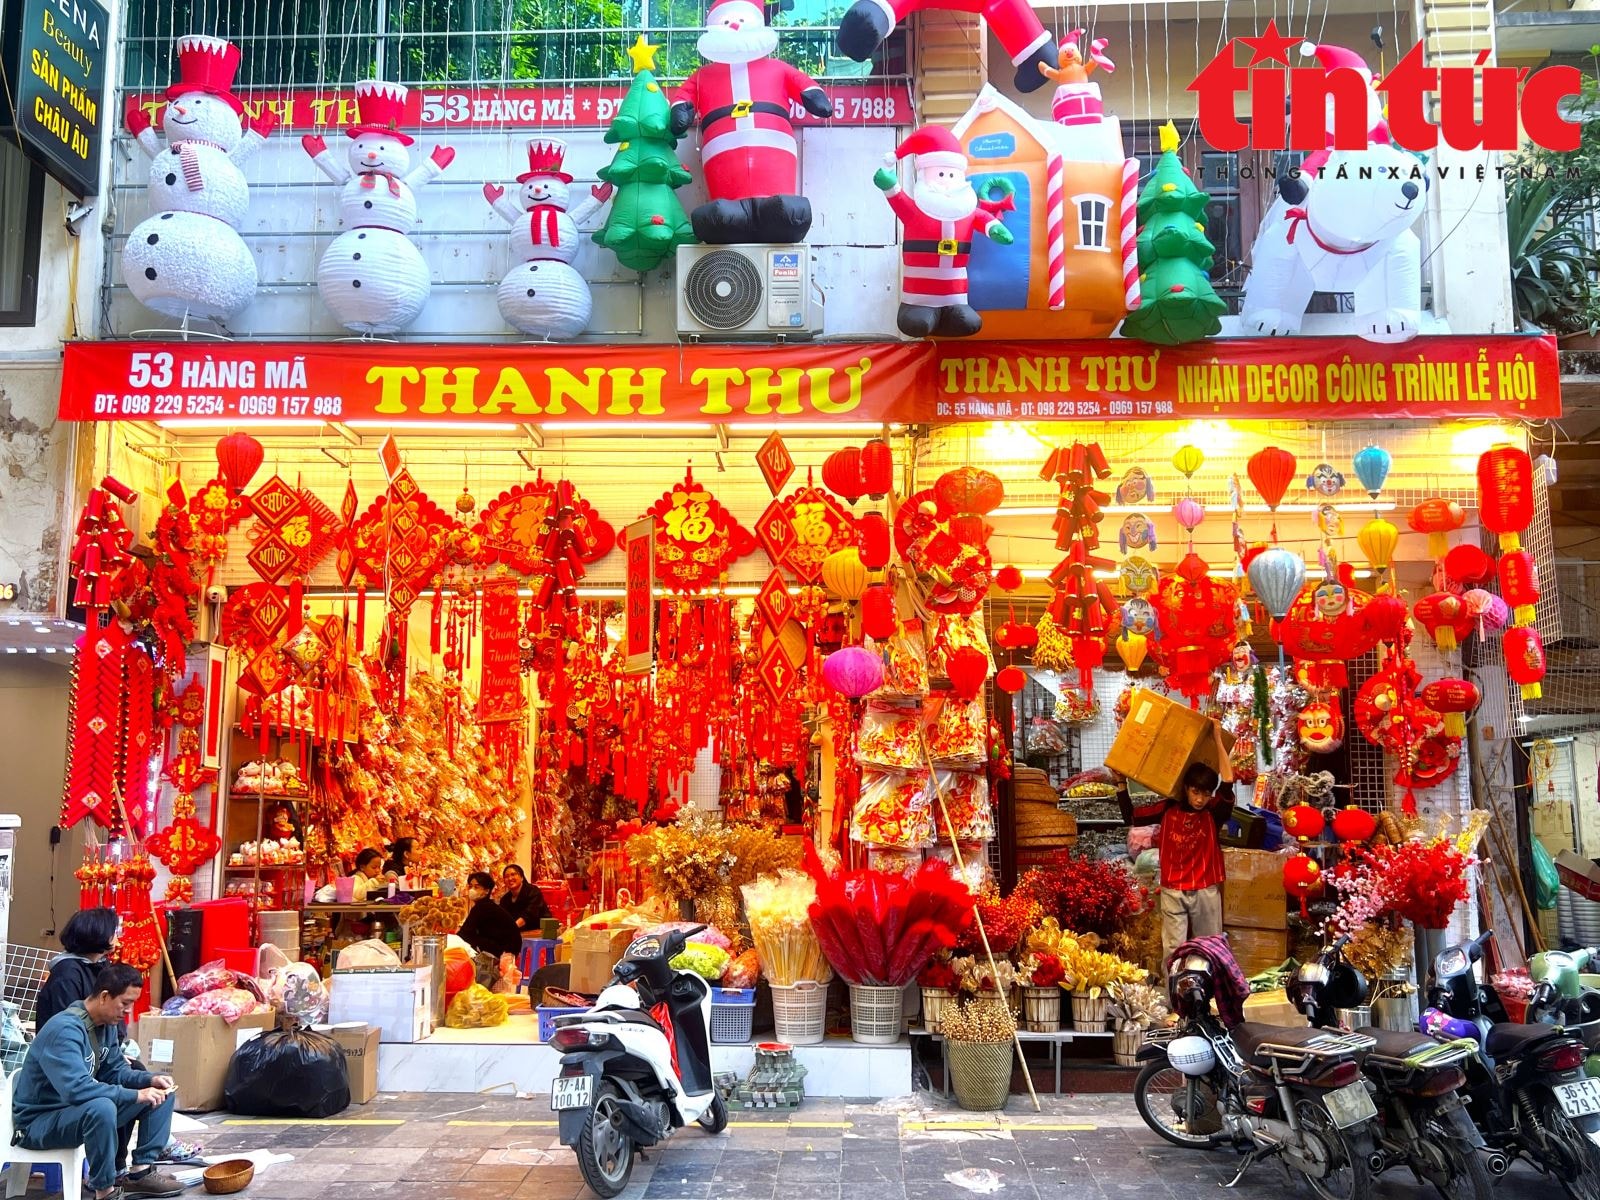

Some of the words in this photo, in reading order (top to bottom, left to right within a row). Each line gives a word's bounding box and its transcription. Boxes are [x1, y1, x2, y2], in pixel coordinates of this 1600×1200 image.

[42, 8, 93, 78] Beauty
[31, 48, 59, 92] SẢN
[61, 77, 97, 127] PHẨM
[420, 94, 470, 123] 53
[472, 93, 536, 121] HÀNG
[541, 94, 576, 121] MÃ
[851, 97, 896, 119] 7988
[34, 96, 70, 144] CHÂU
[71, 124, 89, 160] ÂU
[128, 352, 174, 389] 53
[182, 355, 255, 388] HÀNG
[264, 355, 307, 388] MÃ
[940, 356, 1071, 393] THANH
[1081, 349, 1160, 391] THƯ
[1177, 358, 1240, 412] NHẬN
[1246, 363, 1320, 403] DECOR
[1326, 355, 1386, 401] CÔNG
[1392, 354, 1458, 401] TRÌNH
[1464, 348, 1492, 401] LỄ
[1498, 353, 1537, 410] HỘI
[366, 365, 666, 416] THANH
[690, 357, 872, 415] THƯ
[94, 394, 118, 414] ĐT:
[122, 395, 150, 414] 098
[155, 395, 183, 414] 229
[186, 396, 224, 415] 5254
[239, 396, 276, 415] 0969
[282, 396, 309, 415] 157
[313, 396, 342, 416] 988
[955, 401, 966, 415] 55
[968, 399, 994, 415] HÀNG
[997, 399, 1012, 415] MÃ
[1021, 401, 1035, 415] ĐT:
[1037, 401, 1054, 415] 098
[1057, 401, 1074, 415] 229
[1077, 401, 1100, 415] 5254
[1110, 401, 1133, 415] 0969
[1136, 401, 1152, 414] 157
[1155, 400, 1174, 414] 988
[767, 446, 787, 480] VẠN
[261, 487, 290, 513] CHÚC
[663, 491, 716, 543] 福
[790, 502, 832, 545] 福
[769, 519, 787, 547] SỰ
[259, 542, 287, 567] MỪNG
[394, 589, 410, 605] MỚI
[770, 588, 787, 615] NHƯ
[260, 598, 278, 625] NĂM
[773, 658, 785, 688] Ý
[558, 1077, 586, 1092] 37-AA
[1560, 1080, 1598, 1099] 36-F1
[555, 1092, 589, 1108] 100.12
[1564, 1095, 1600, 1115] 479.1
